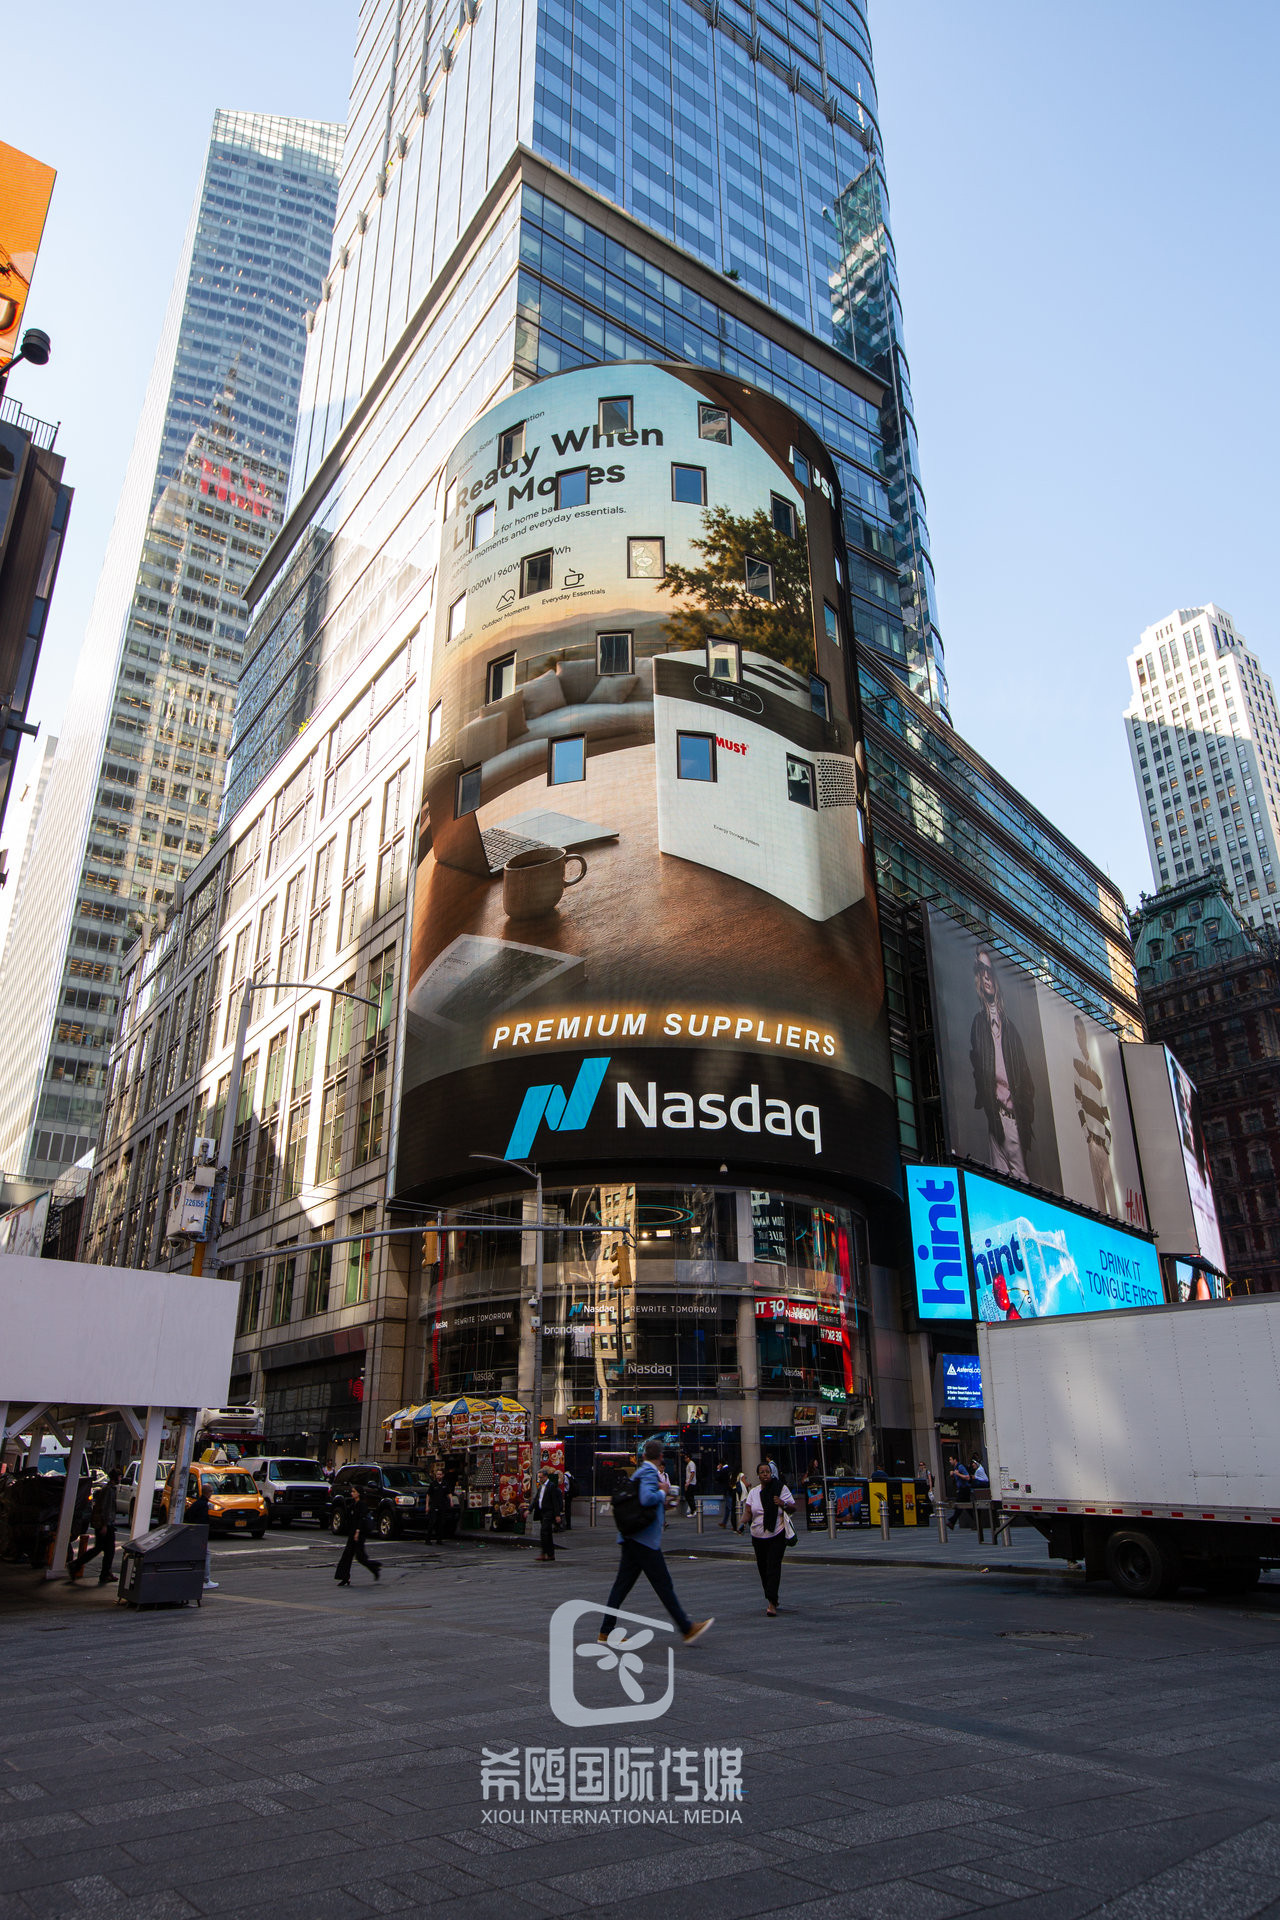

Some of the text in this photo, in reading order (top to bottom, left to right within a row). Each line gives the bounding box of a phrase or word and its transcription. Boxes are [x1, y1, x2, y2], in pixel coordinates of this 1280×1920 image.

[551, 424, 664, 456] When
[507, 464, 626, 511] Moes
[474, 536, 509, 561] moments
[510, 527, 527, 540] and
[529, 513, 571, 531] everyday
[574, 506, 628, 519] essentials.
[501, 522, 513, 534] for
[514, 510, 540, 526] home
[541, 588, 606, 606] Everyday Essentials
[481, 605, 530, 630] Outdoor Moments
[492, 1013, 836, 1057] PREMIUM SUPPLIERS
[616, 1081, 823, 1155] Nasdaq
[1125, 1187, 1145, 1228] H&M
[916, 1179, 966, 1305] hint
[972, 1231, 1024, 1290] hint
[1099, 1249, 1141, 1282] DRINK IT
[1086, 1270, 1158, 1307] TONGUE FIRST
[454, 1316, 475, 1326] REWRITE
[478, 1311, 513, 1322] TOMORROW
[583, 1304, 718, 1314] Nasdaq REWRITE TOMORROW
[544, 1324, 586, 1335] branded
[628, 1362, 673, 1377] Nasdaq
[783, 1367, 804, 1379] Nasdaq
[836, 1488, 863, 1515] AMAZE
